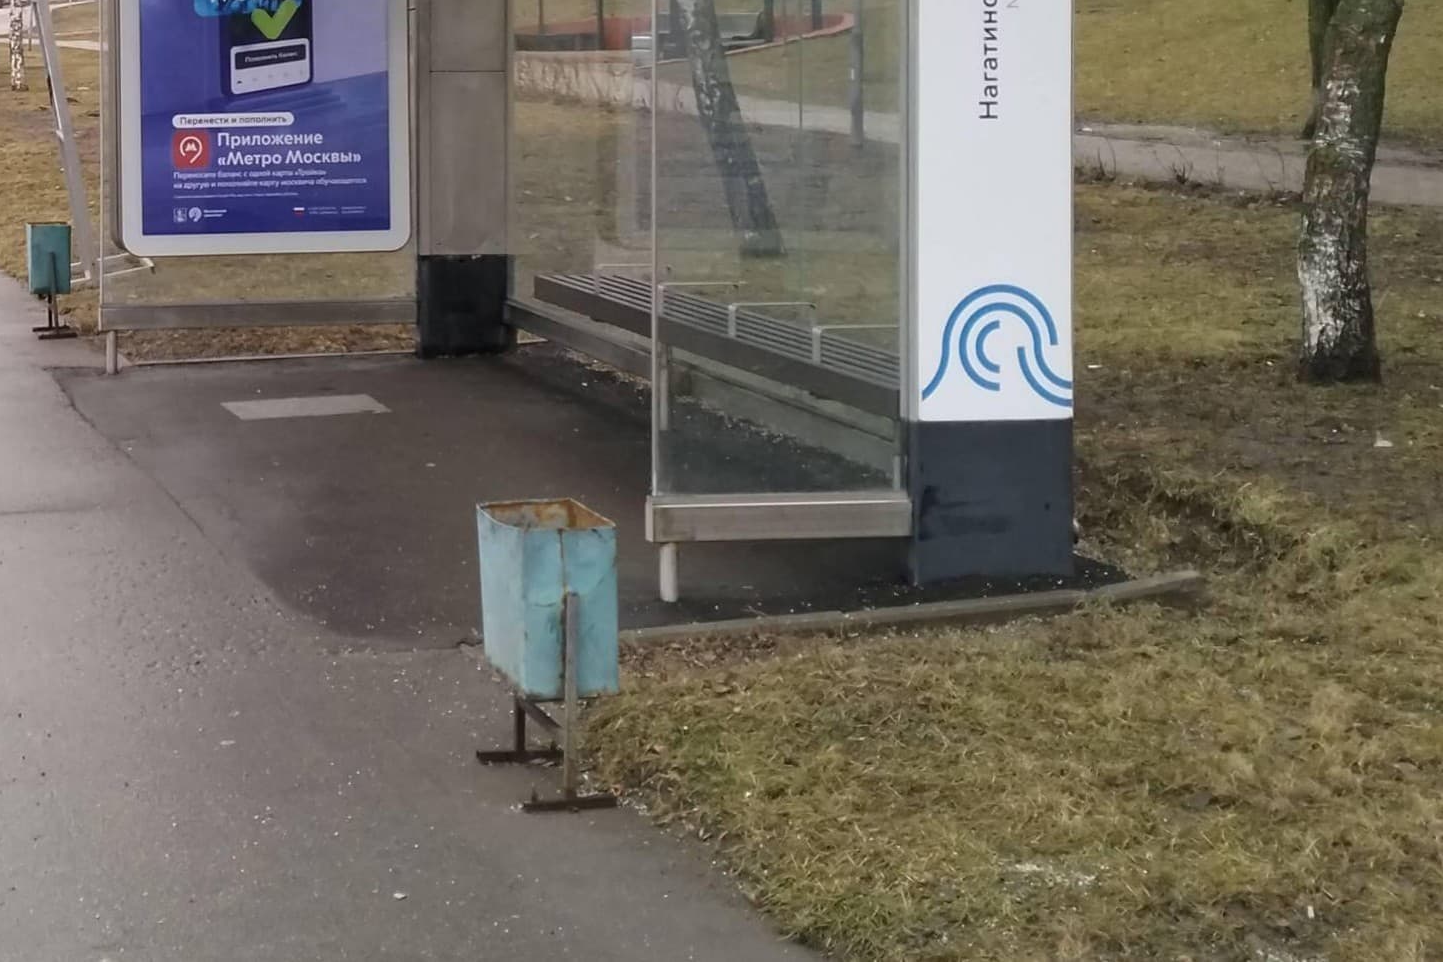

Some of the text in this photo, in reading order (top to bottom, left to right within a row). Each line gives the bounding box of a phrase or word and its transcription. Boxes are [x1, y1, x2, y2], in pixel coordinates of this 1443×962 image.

[179, 116, 229, 126] Перенести
[239, 116, 287, 124] пополнить
[217, 132, 323, 150] Приложение
[217, 149, 362, 167] «Метро Москвы»
